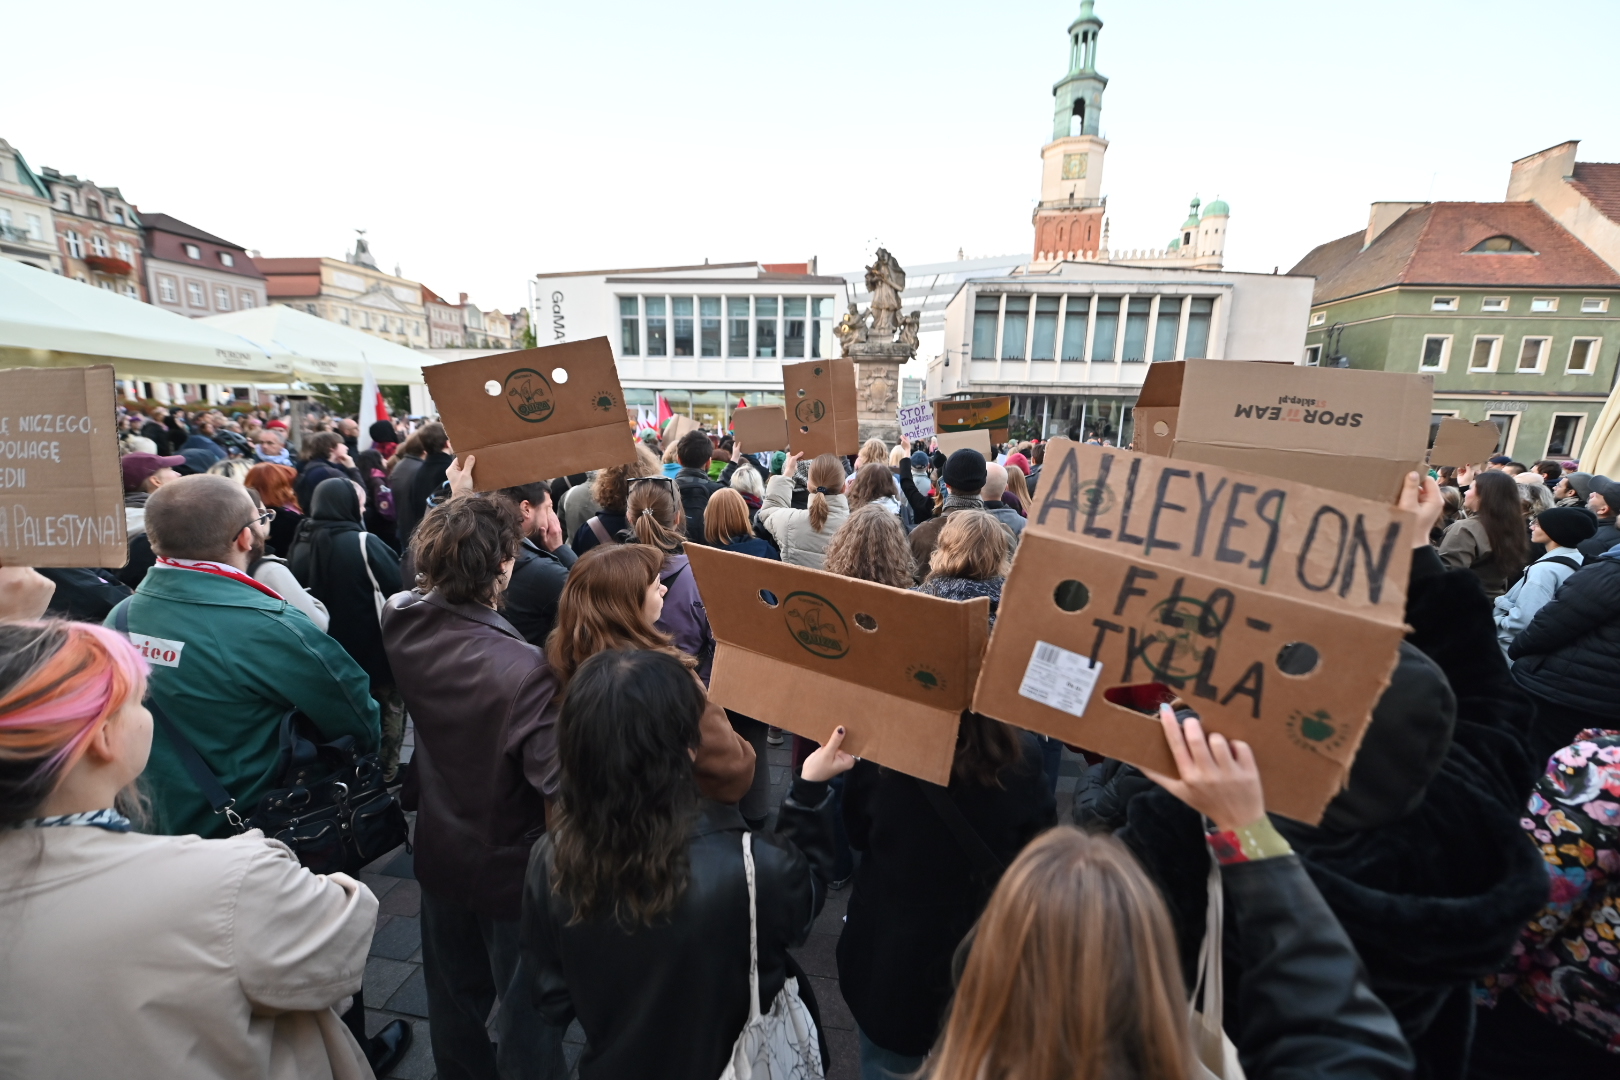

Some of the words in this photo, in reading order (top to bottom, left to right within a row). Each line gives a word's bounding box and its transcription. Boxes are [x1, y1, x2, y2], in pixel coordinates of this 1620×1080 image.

[551, 290, 566, 340] GaMA
[18, 414, 98, 434] NICZEGO,
[899, 404, 926, 421] STOP
[1295, 504, 1403, 606] ON
[1091, 617, 1266, 720] TYLLA
